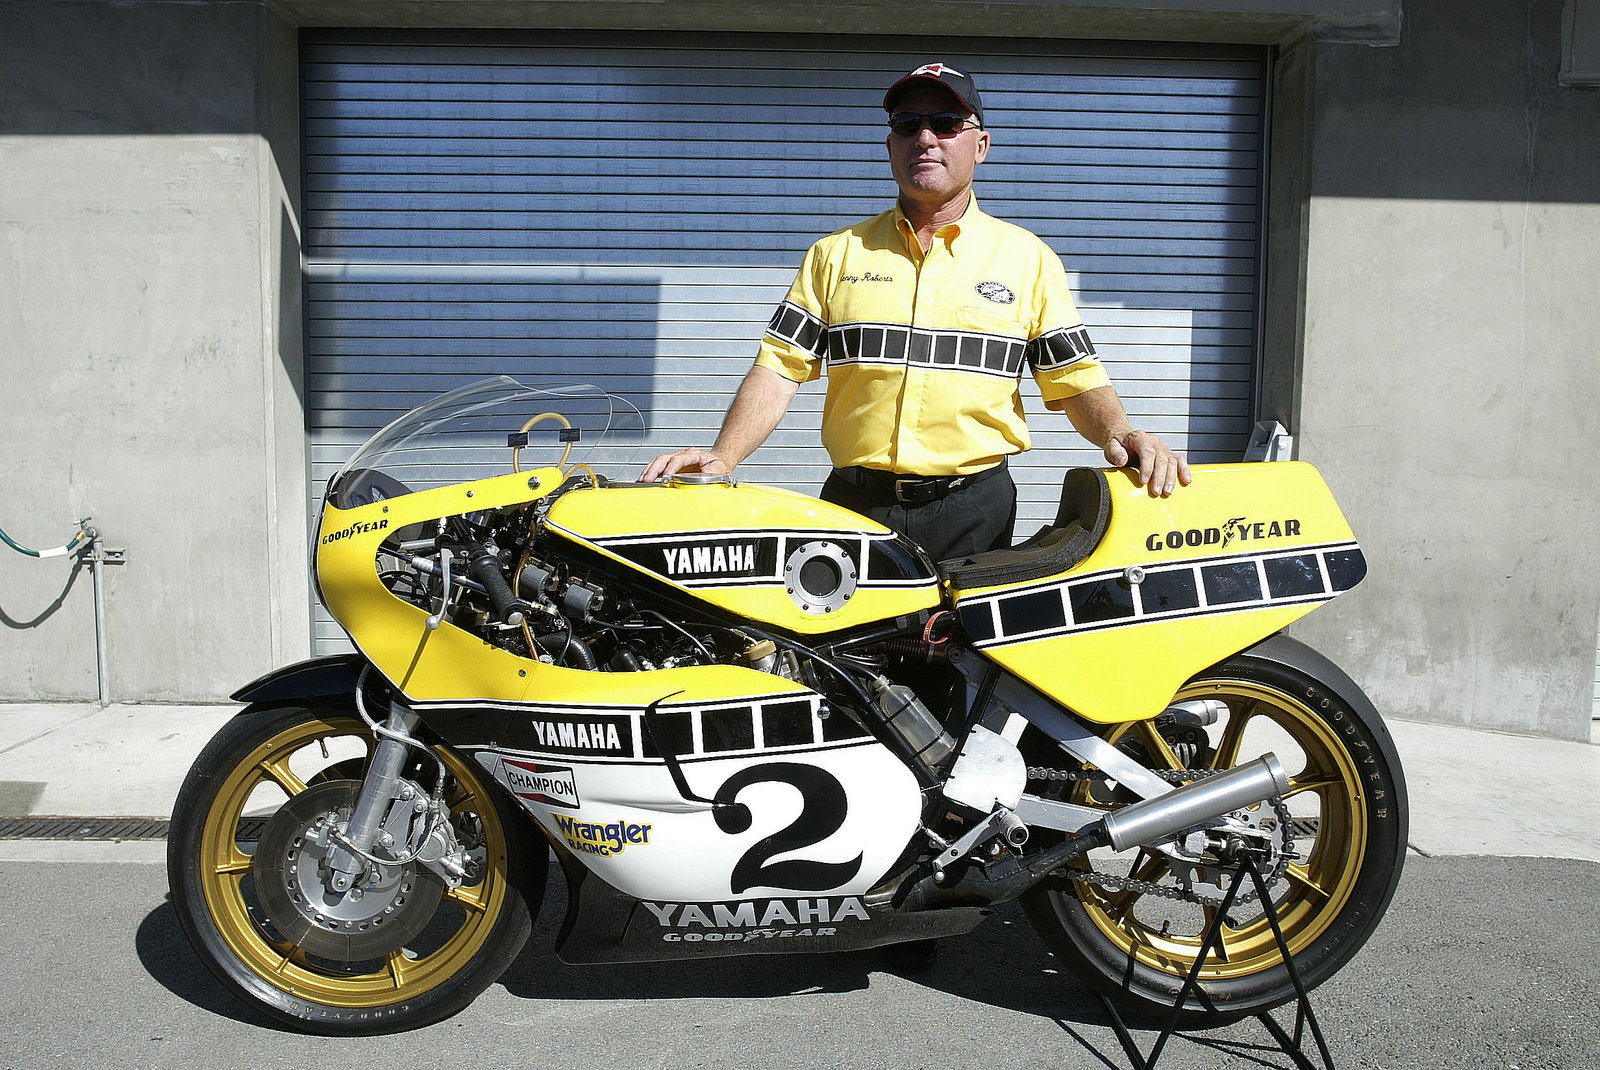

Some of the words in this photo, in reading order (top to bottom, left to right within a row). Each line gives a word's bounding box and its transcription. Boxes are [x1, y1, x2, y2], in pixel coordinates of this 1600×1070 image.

[662, 544, 755, 575] YAMAHA
[532, 720, 622, 750] YAMAHA
[508, 771, 574, 796] CHAMPION
[552, 813, 651, 852] Wrangler
[711, 762, 864, 895] 2
[568, 838, 610, 856] RACING
[641, 897, 870, 928] YAMAHA
